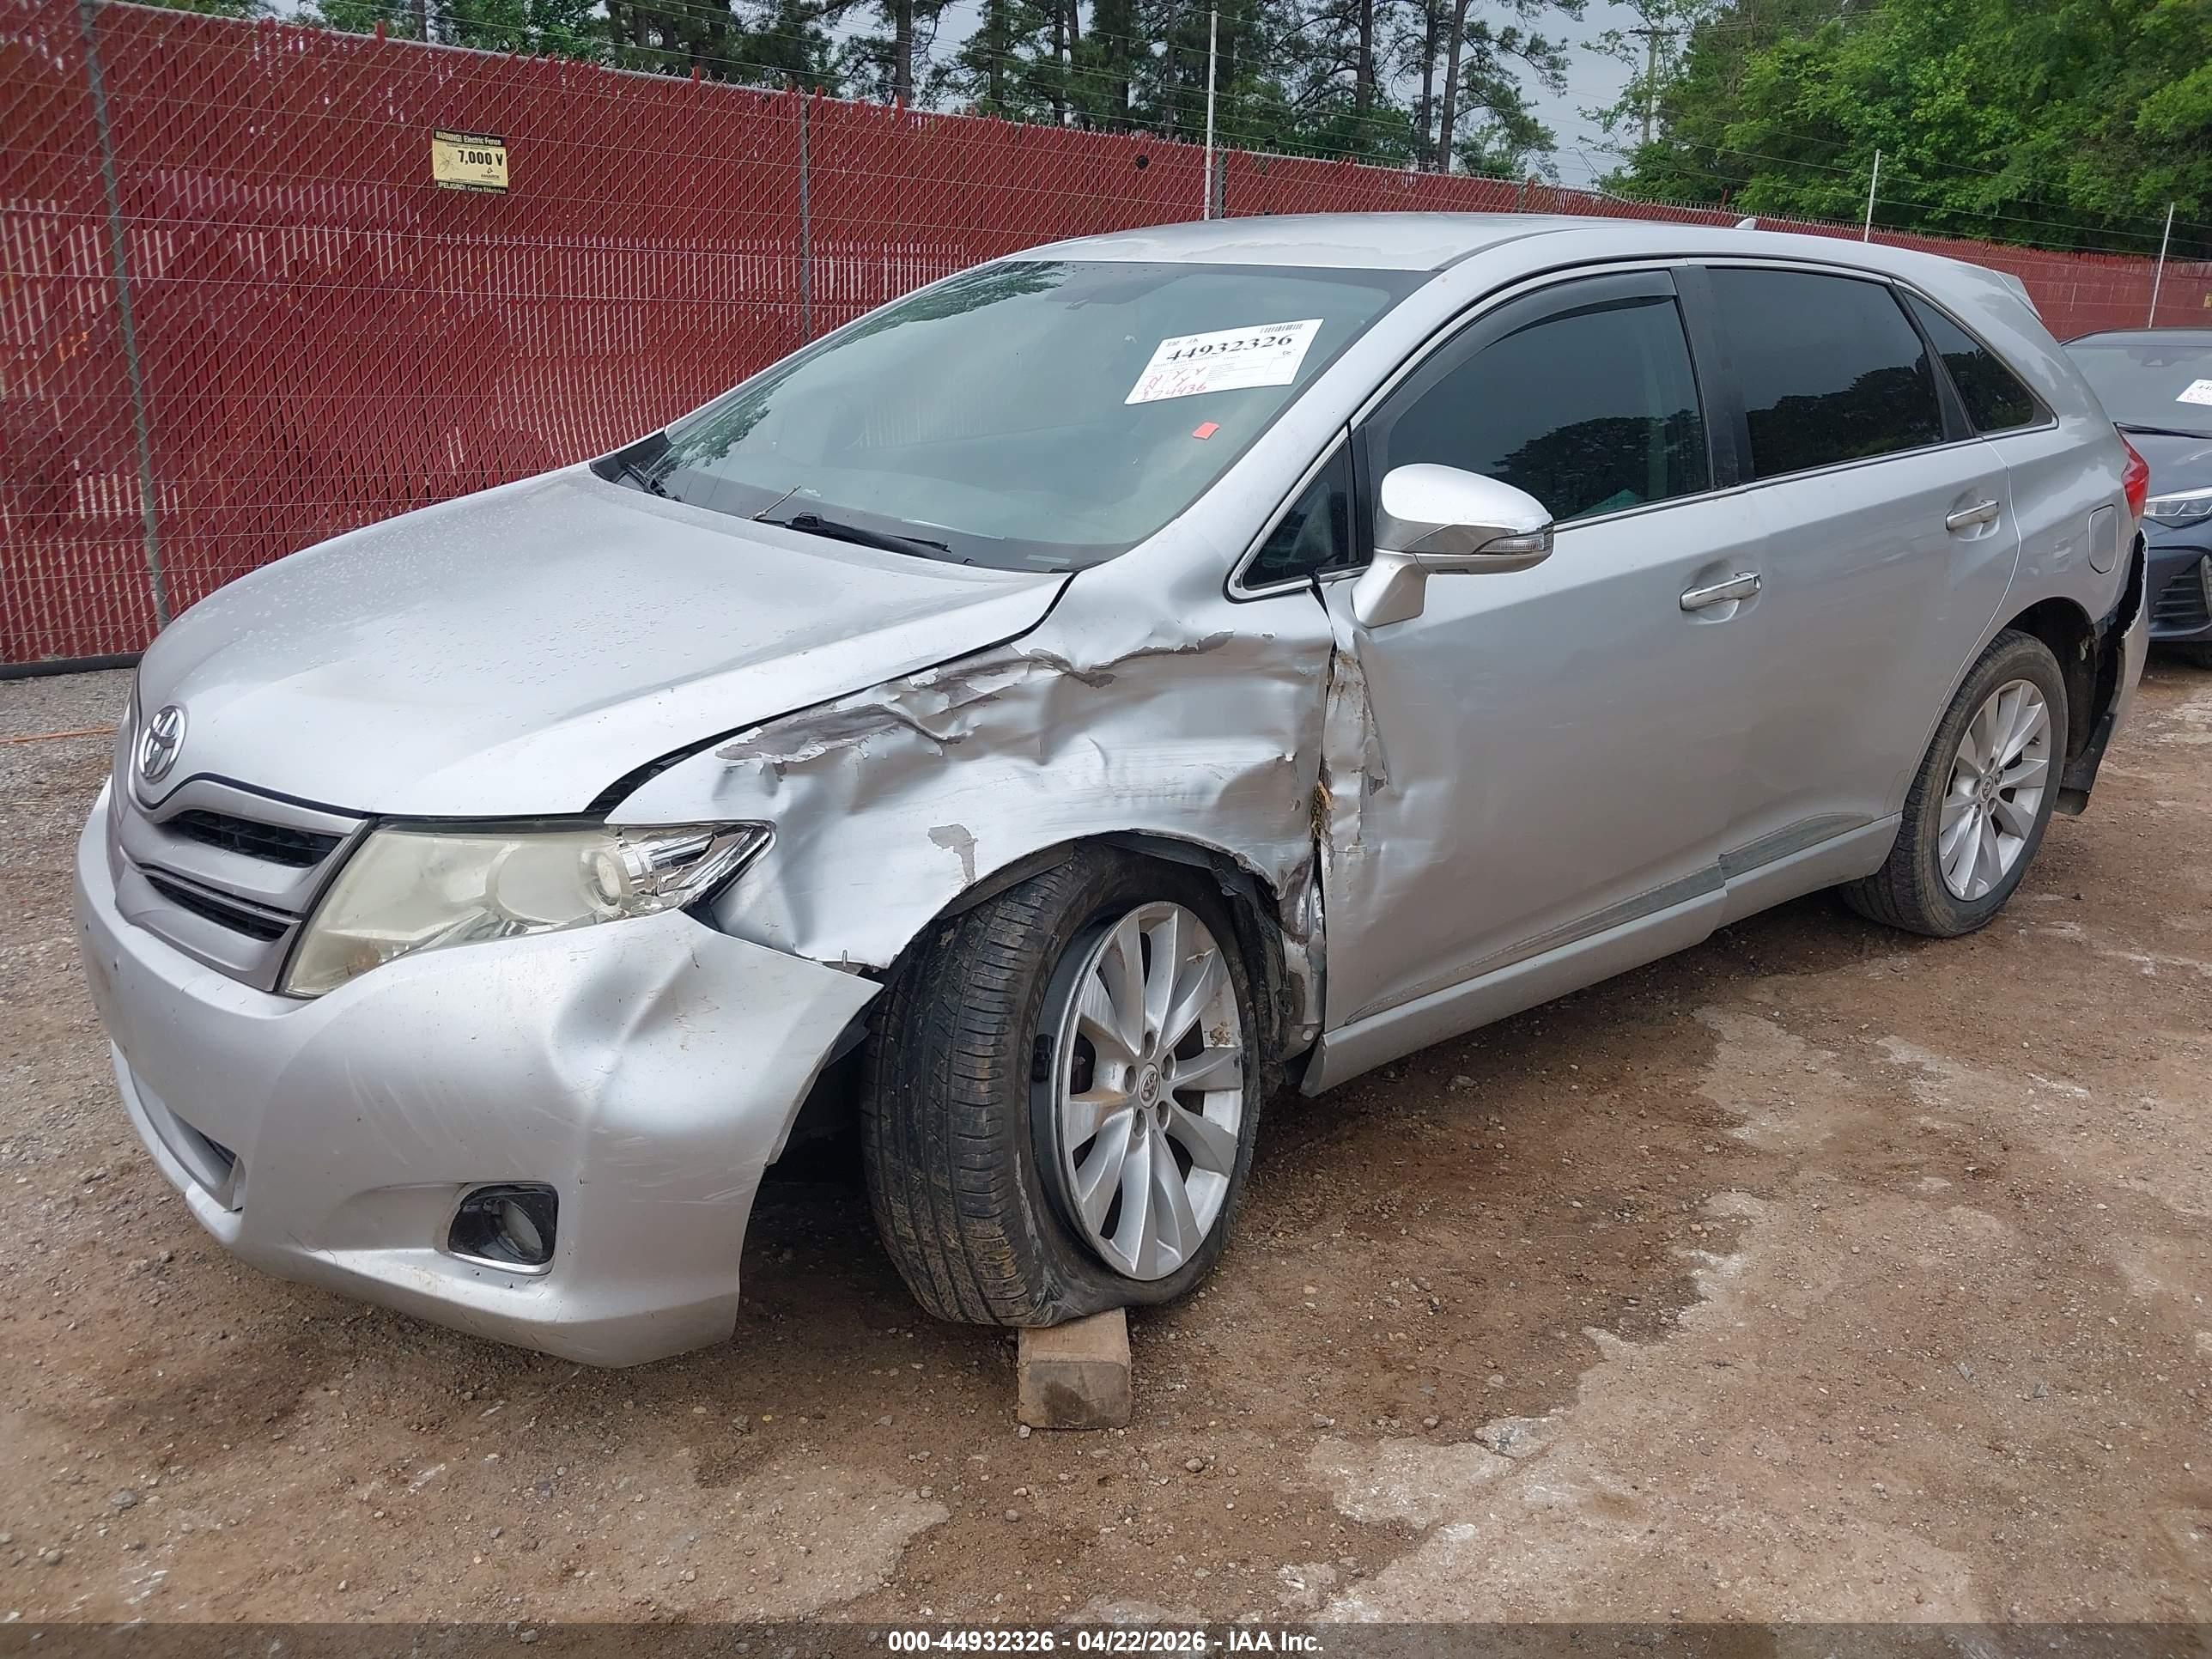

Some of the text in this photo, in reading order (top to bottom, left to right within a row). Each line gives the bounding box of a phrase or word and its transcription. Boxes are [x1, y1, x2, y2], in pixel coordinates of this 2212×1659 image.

[436, 131, 501, 146] WARNING! Electric Fence
[458, 150, 503, 167] 7,000 V
[1166, 334, 1294, 362] 44932326
